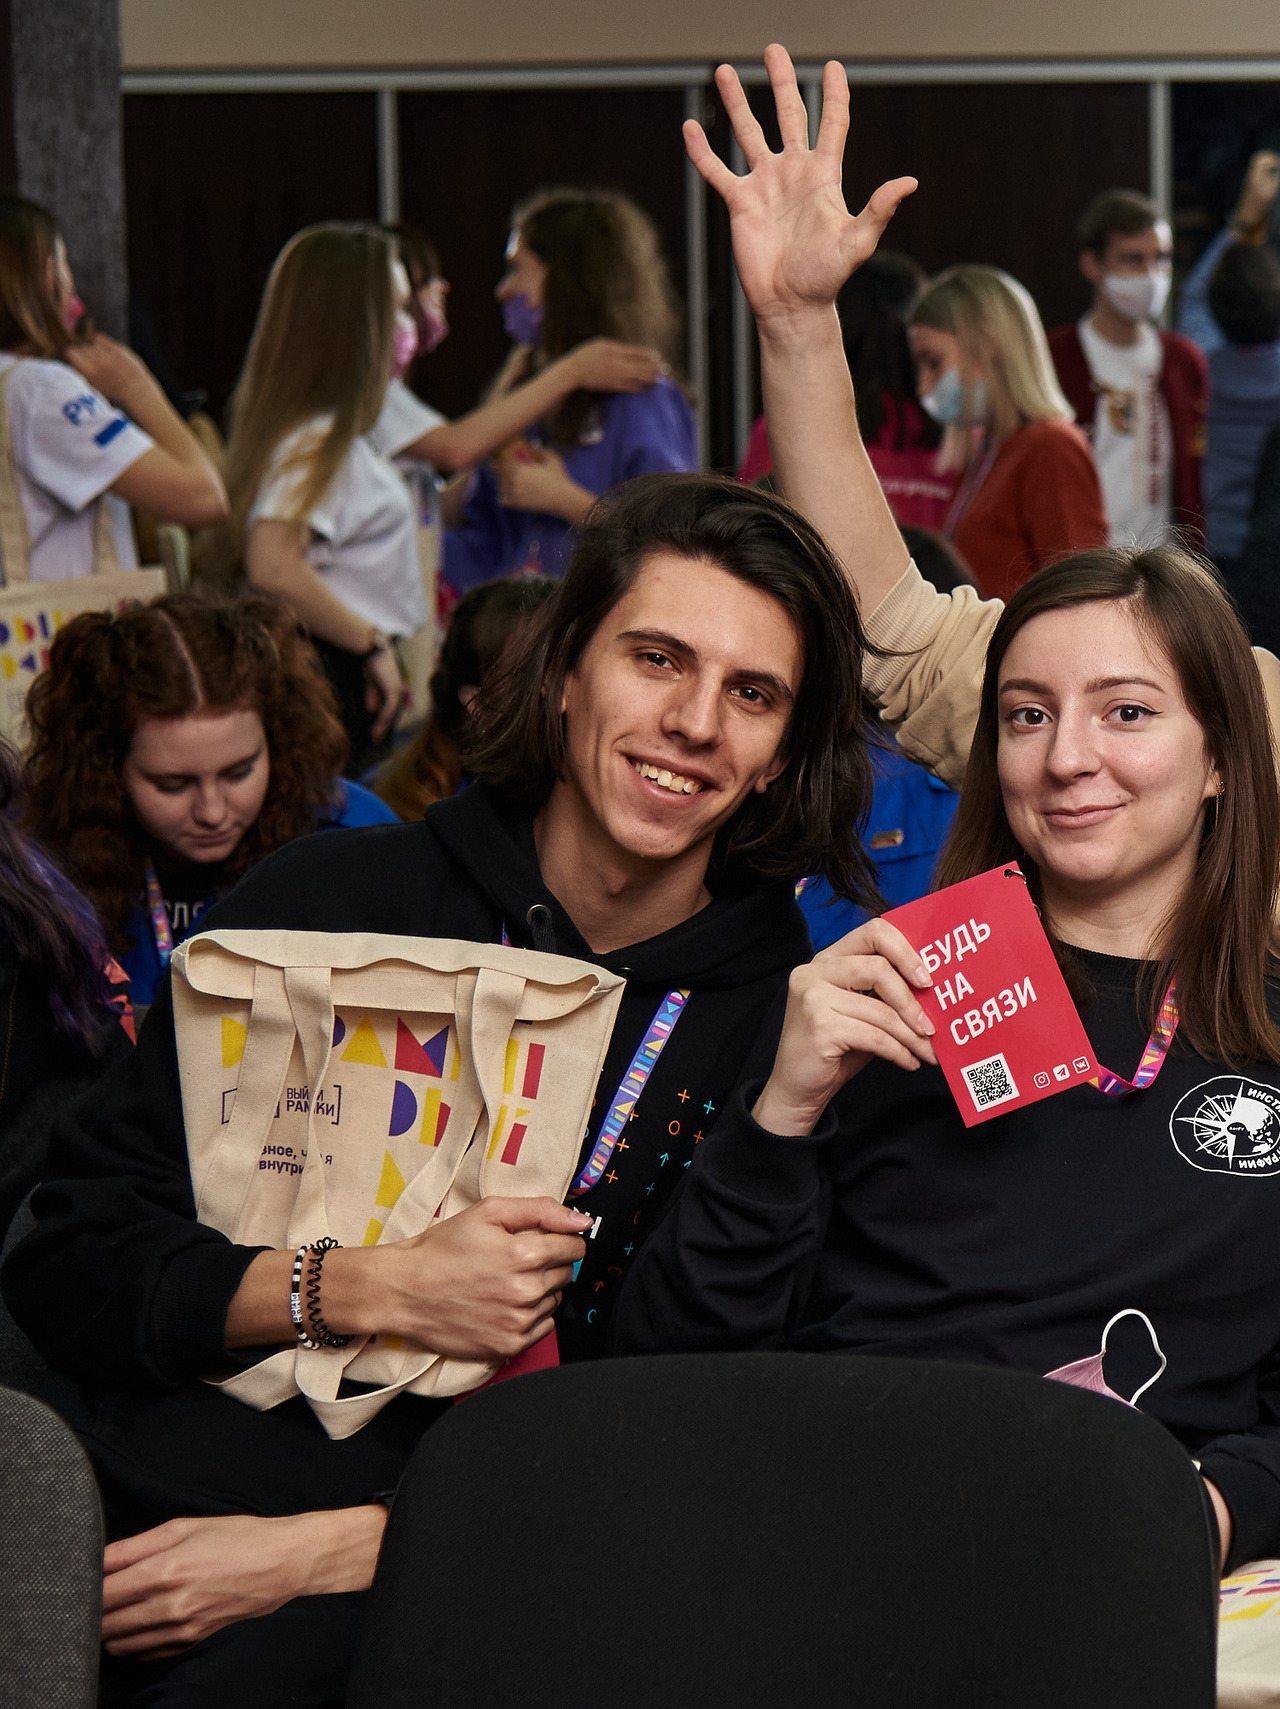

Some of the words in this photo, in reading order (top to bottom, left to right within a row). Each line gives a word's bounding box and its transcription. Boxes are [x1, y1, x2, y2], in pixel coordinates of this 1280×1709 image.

[919, 918, 991, 974] БУДЬ
[934, 971, 975, 1011] НА
[950, 976, 1038, 1046] СВЯЗИ
[286, 1085, 324, 1101] ВЫЙИ
